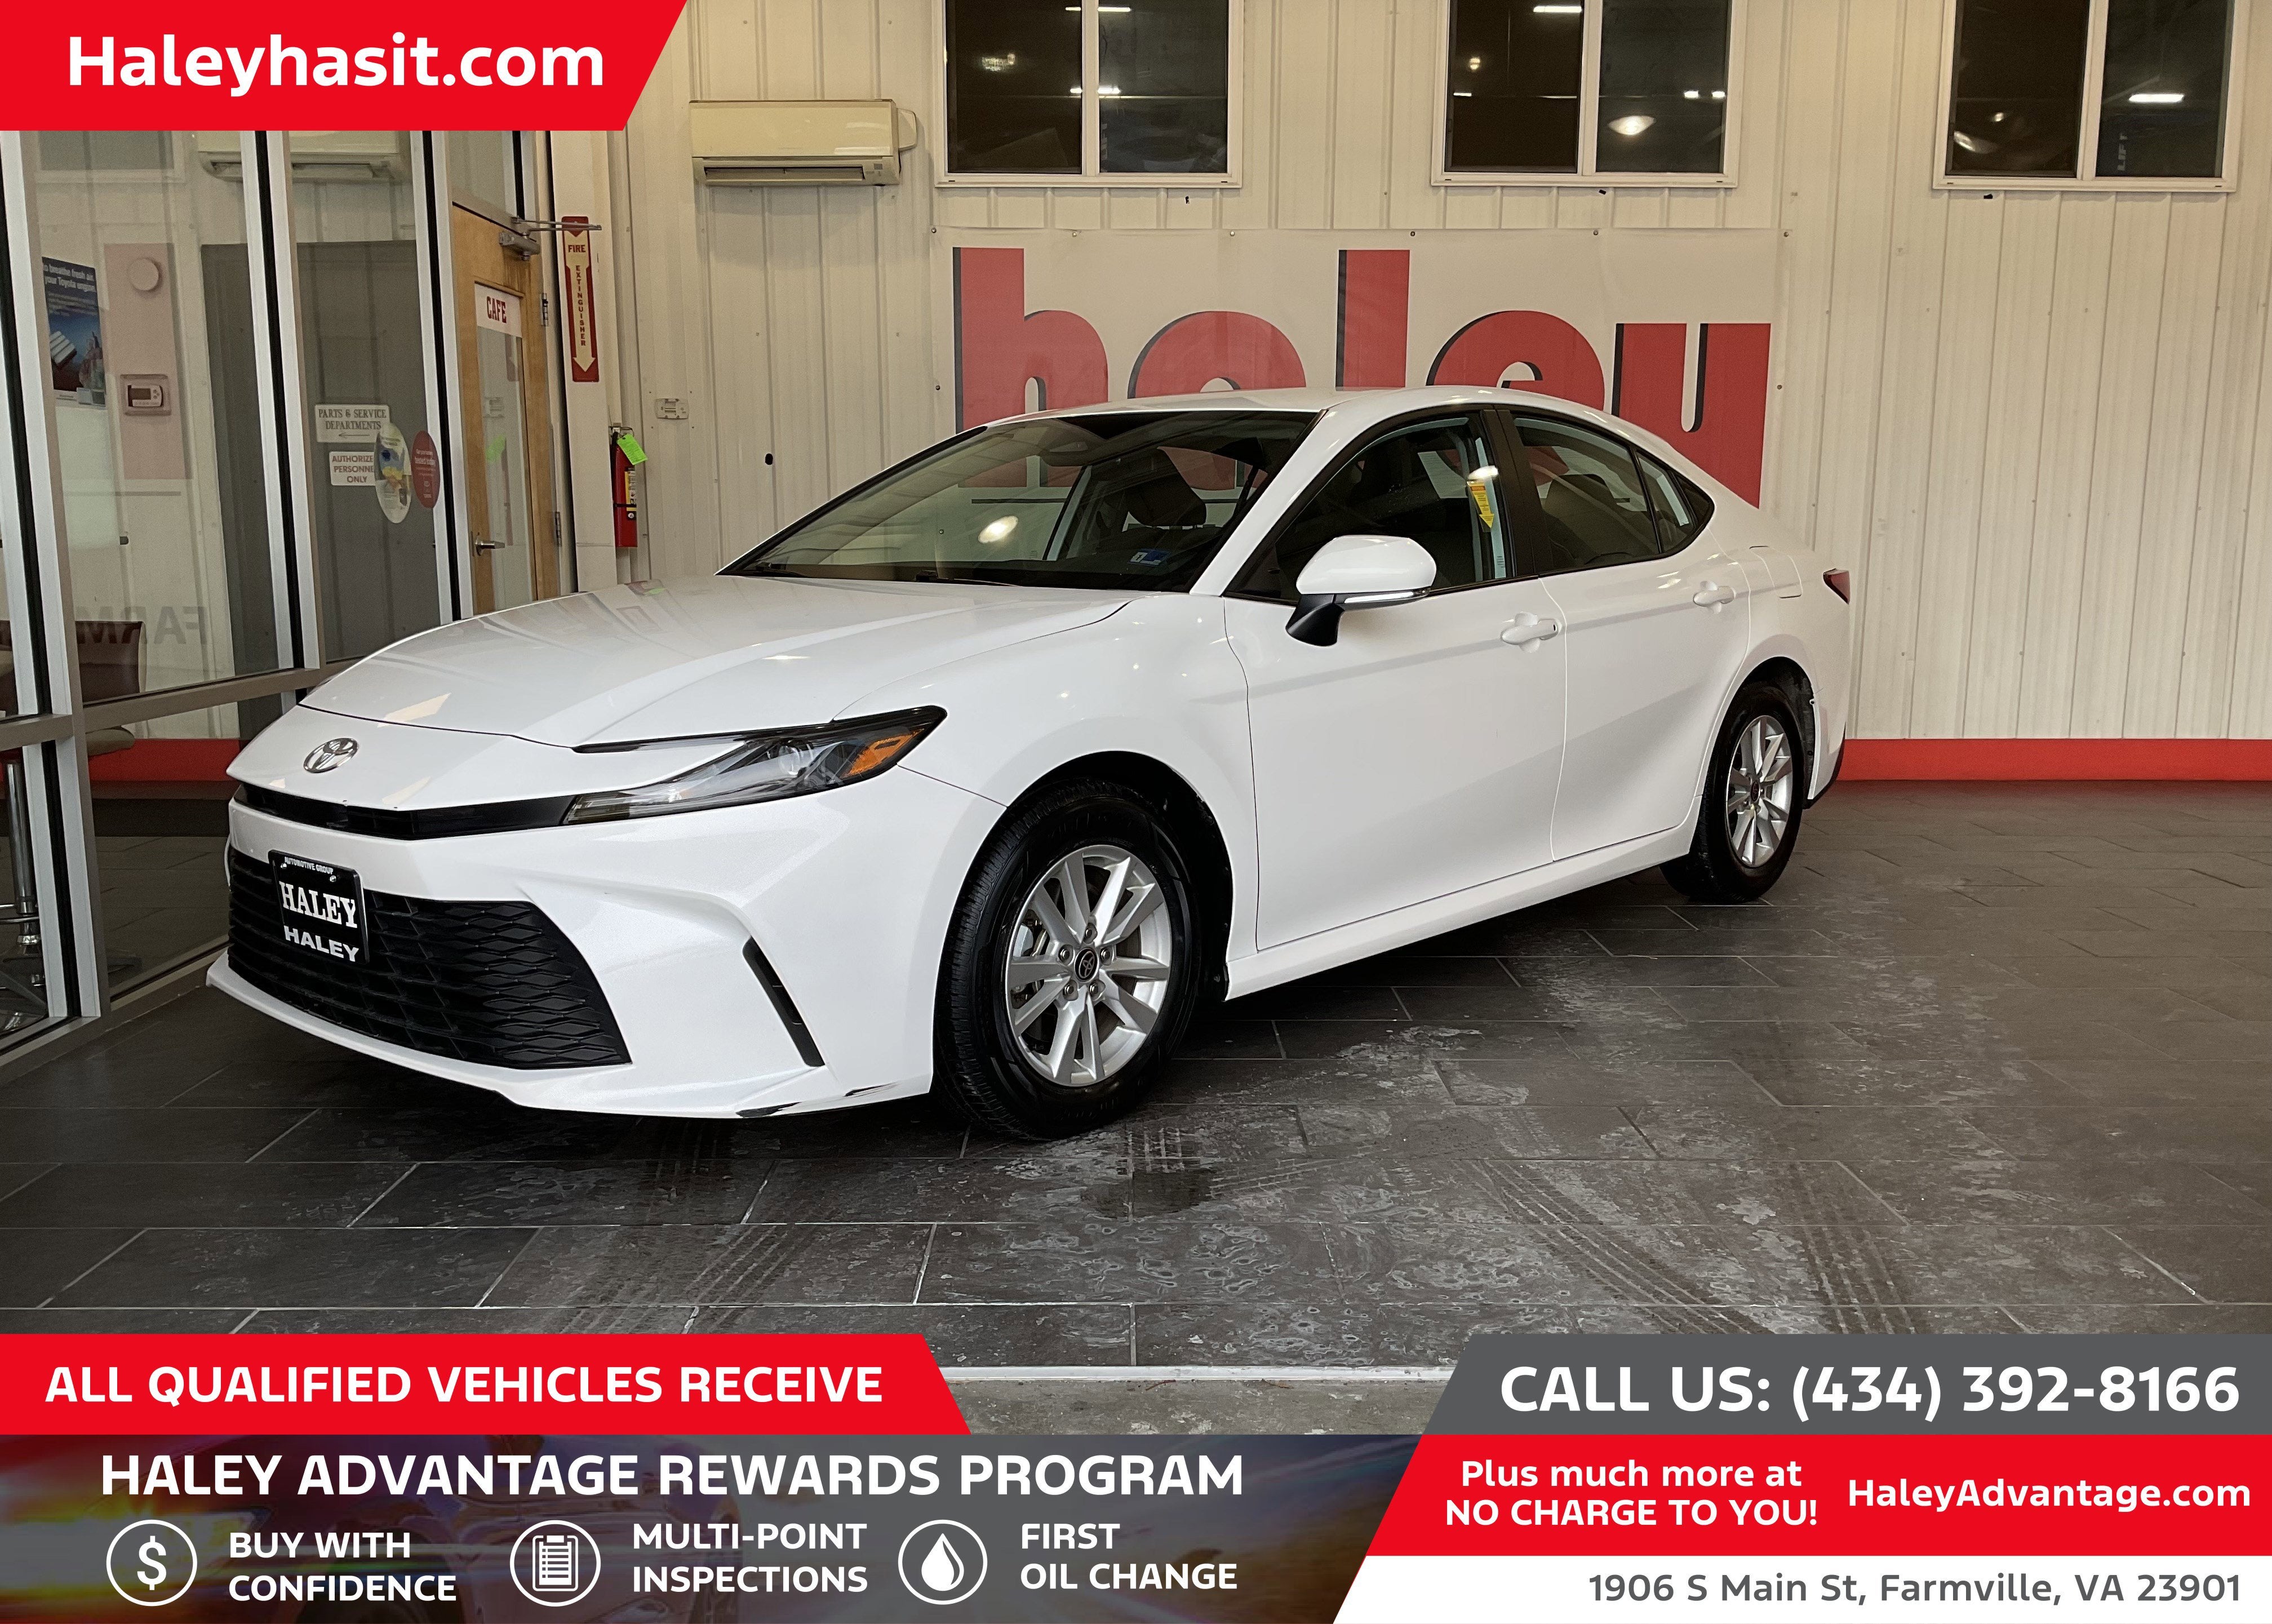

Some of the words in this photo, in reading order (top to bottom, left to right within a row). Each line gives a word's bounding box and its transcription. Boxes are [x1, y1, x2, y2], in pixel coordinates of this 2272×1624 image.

[567, 244, 586, 254] FIRE
[57, 277, 76, 289] Toyota
[486, 296, 507, 324] CAFE
[575, 265, 586, 346] EXTINGUISHER
[318, 409, 343, 418] PARTS
[345, 409, 351, 418] &
[354, 409, 387, 418] SERVICE
[325, 420, 381, 430] DEPARTMENTS
[285, 857, 316, 871] AUTOMOTIVE
[316, 864, 334, 875] GROUP
[279, 881, 357, 929] HALEY
[284, 925, 359, 962] HALEY
